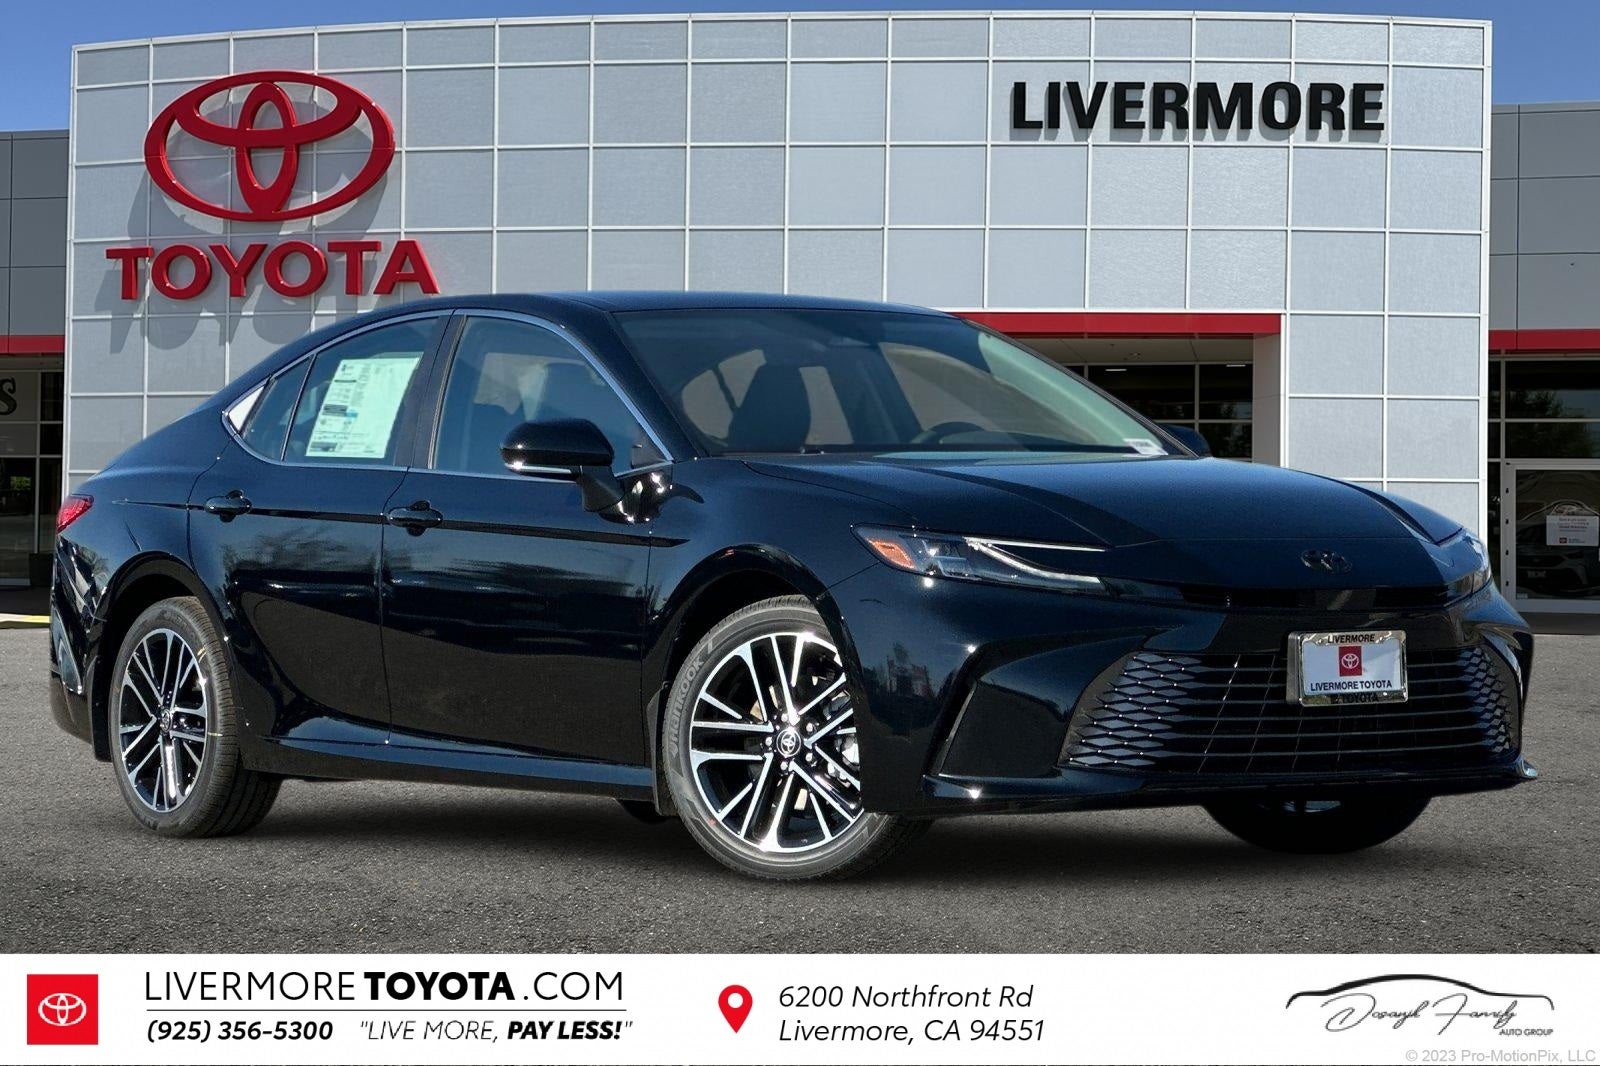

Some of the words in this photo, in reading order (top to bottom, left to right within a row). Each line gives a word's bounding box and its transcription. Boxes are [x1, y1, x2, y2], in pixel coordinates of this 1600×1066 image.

[1010, 80, 1385, 132] LIVERMORE
[105, 239, 441, 301] TOYOTA
[1327, 633, 1375, 644] LIVERMORE
[1310, 681, 1358, 692] LIVERMORE
[1360, 679, 1393, 689] TOYOTA
